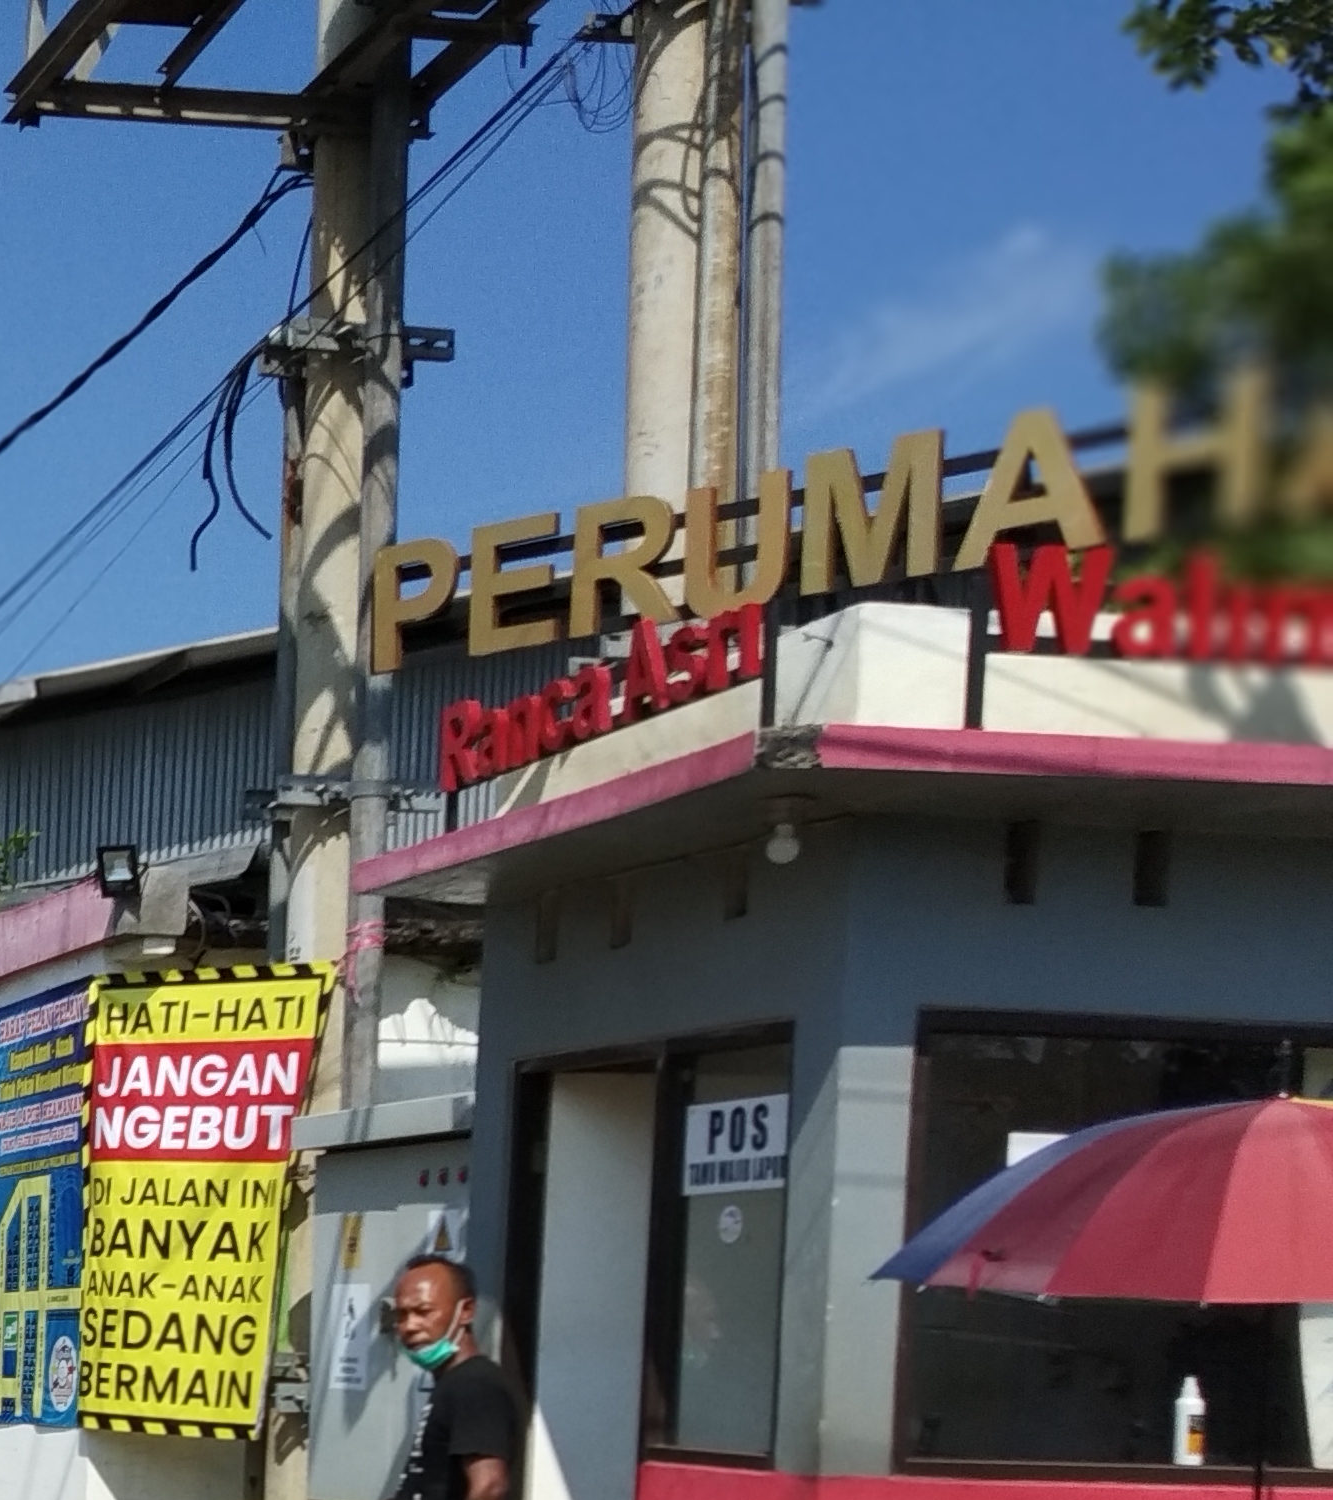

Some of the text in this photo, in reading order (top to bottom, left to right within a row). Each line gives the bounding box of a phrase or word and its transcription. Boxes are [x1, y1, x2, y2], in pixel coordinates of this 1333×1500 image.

[371, 365, 1333, 673] PERUMAH
[440, 602, 764, 791] Ranca Asri
[105, 995, 305, 1035] HATI-HATI
[97, 1051, 300, 1098] JANGAN
[94, 1104, 294, 1150] NGEBUT
[708, 1103, 769, 1155] POS
[93, 1177, 277, 1209] DI JALAN INI
[89, 1218, 270, 1263] BANYAK
[86, 1270, 264, 1304] ANAK-ANAK
[83, 1307, 257, 1356] SEDANG
[79, 1361, 253, 1410] BERMAIN
